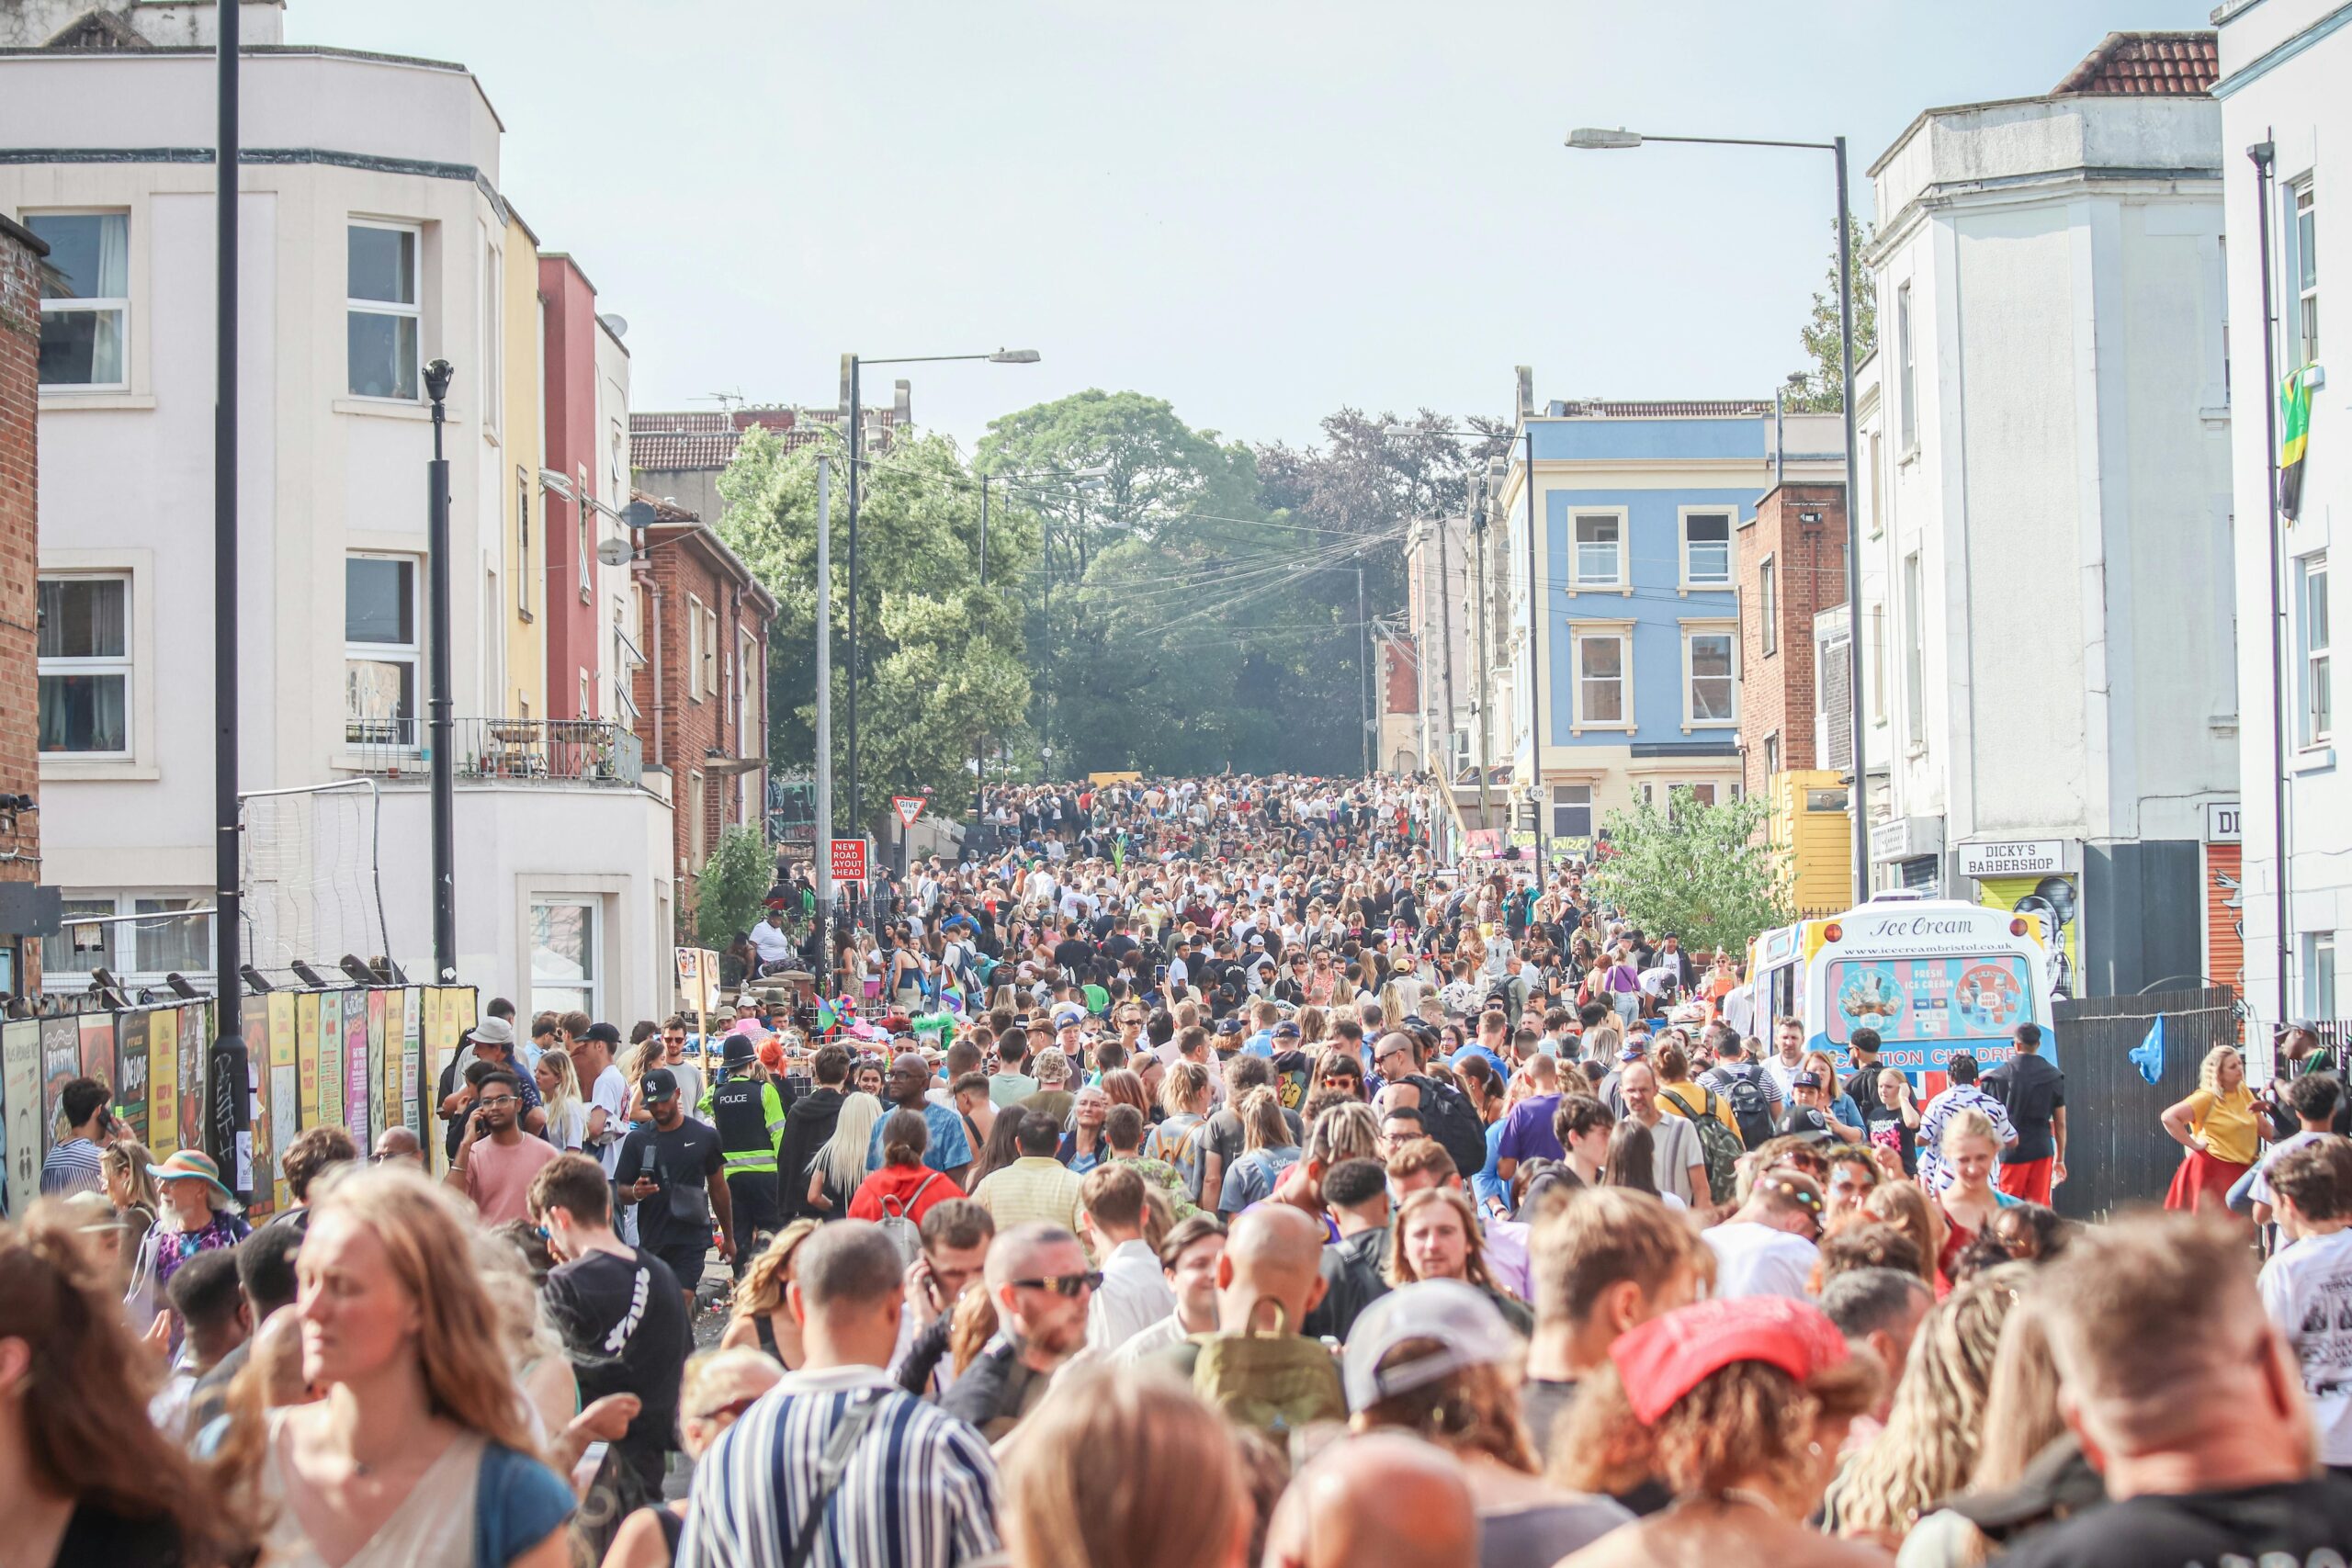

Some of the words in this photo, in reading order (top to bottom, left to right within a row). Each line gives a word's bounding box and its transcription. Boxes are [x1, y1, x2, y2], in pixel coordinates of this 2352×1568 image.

[899, 801, 919, 809] GIVE
[1985, 844, 2036, 858] DICKY'S
[1968, 858, 2054, 873] BARBERSHOP
[831, 868, 861, 876] AHEAD
[1870, 919, 1908, 936] Ice
[1911, 917, 1973, 935] Cream
[1844, 942, 2013, 955] www.icecreambristol.co.uk
[1914, 969, 1943, 978] FRESH
[1905, 981, 1919, 990] ICE
[1921, 979, 1953, 989] CREAM
[719, 1094, 748, 1104] POLICE
